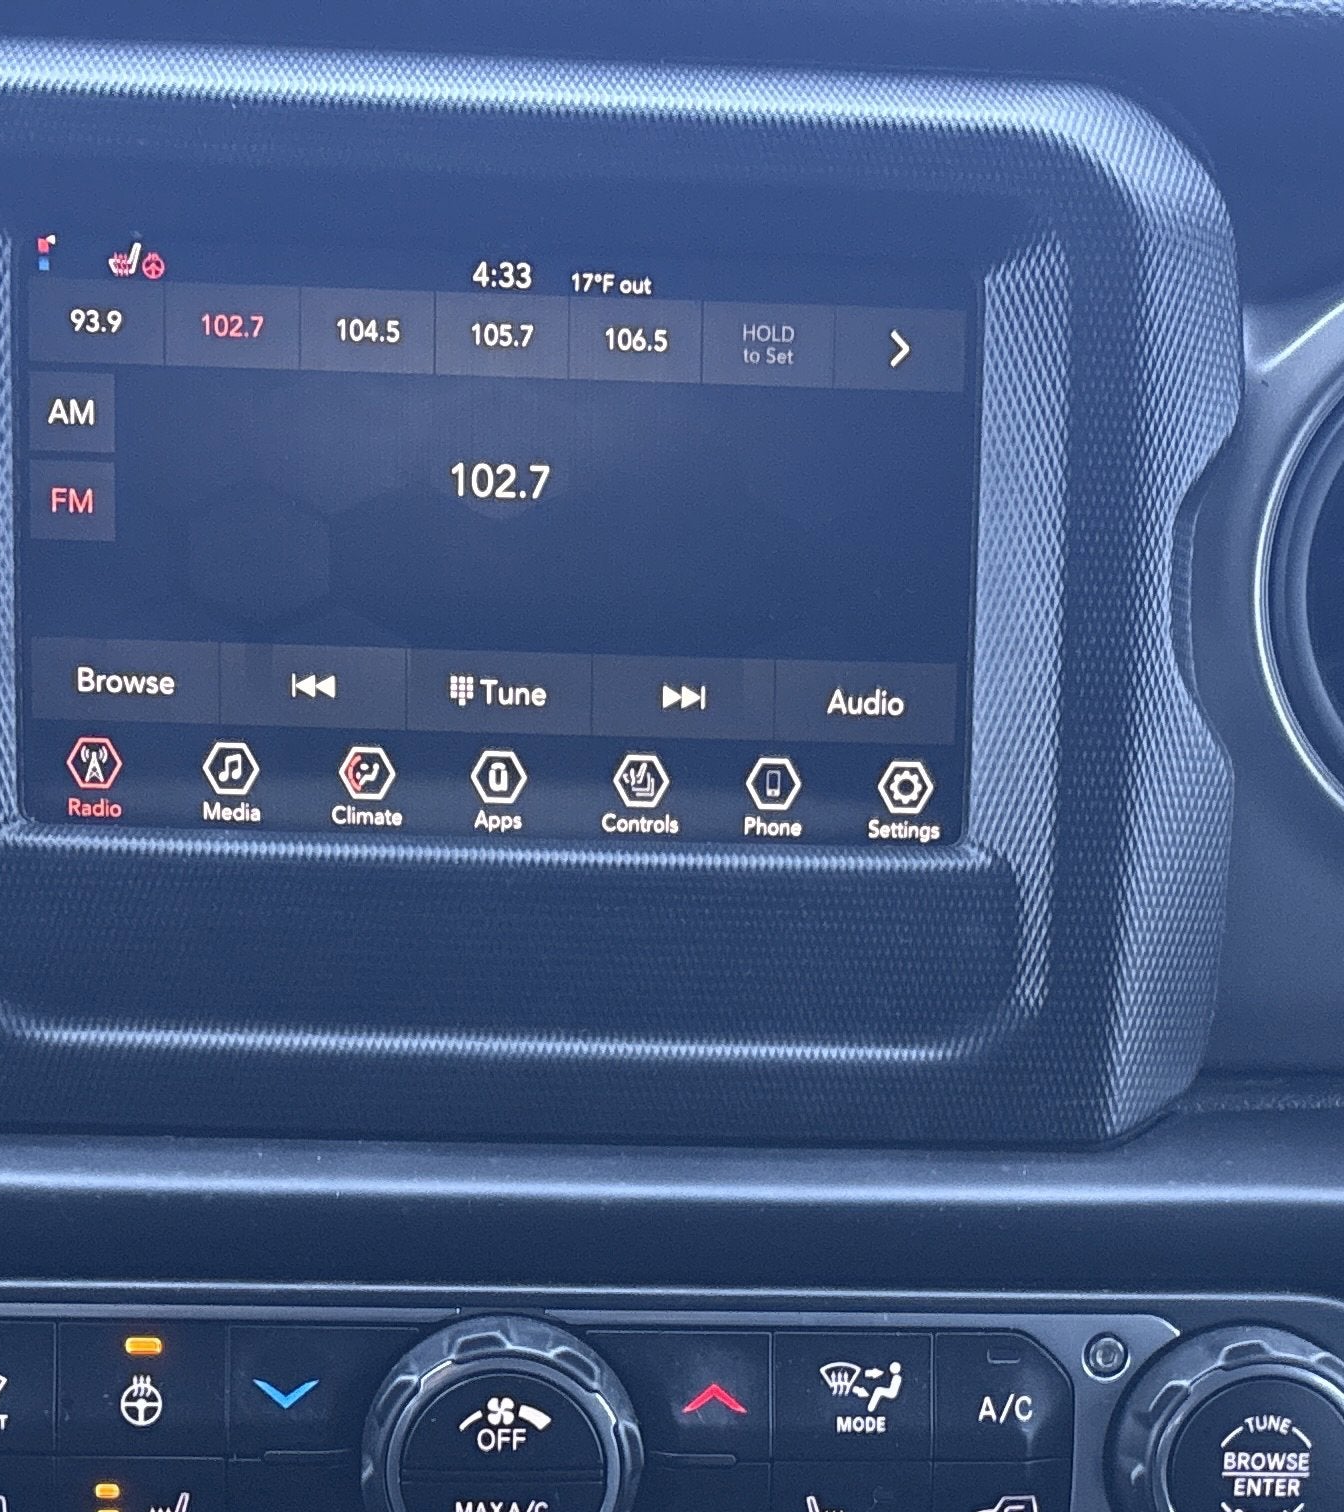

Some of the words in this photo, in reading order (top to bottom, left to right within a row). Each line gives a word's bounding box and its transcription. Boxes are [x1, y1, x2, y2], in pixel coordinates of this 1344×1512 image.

[472, 261, 532, 289] 4:33
[619, 277, 652, 295] out
[70, 308, 122, 333] 93.9
[201, 313, 264, 338] 102.7
[336, 318, 400, 343] 104.5
[742, 323, 795, 343] HOLD
[471, 323, 534, 348] 105.7
[605, 327, 668, 352] 106.5
[743, 348, 761, 364] to
[766, 346, 794, 365] Set
[47, 398, 95, 425] AM
[451, 462, 550, 500] 102.7
[51, 487, 93, 514] FM
[77, 666, 175, 695] Browse
[479, 678, 547, 707] Tune
[826, 688, 905, 716] Audio
[68, 797, 122, 818] Radio
[203, 801, 261, 822] Media
[331, 804, 403, 827] Climate
[474, 809, 523, 833] Apps
[601, 812, 679, 834] Controls
[744, 815, 803, 837] Phone
[868, 818, 941, 843] Settings
[977, 1393, 1034, 1424] A/C
[836, 1416, 886, 1433] MODE
[1244, 1414, 1292, 1436] TUNE
[476, 1423, 527, 1453] OFF
[1222, 1450, 1311, 1471] BROWSE
[1233, 1477, 1301, 1497] ENTER
